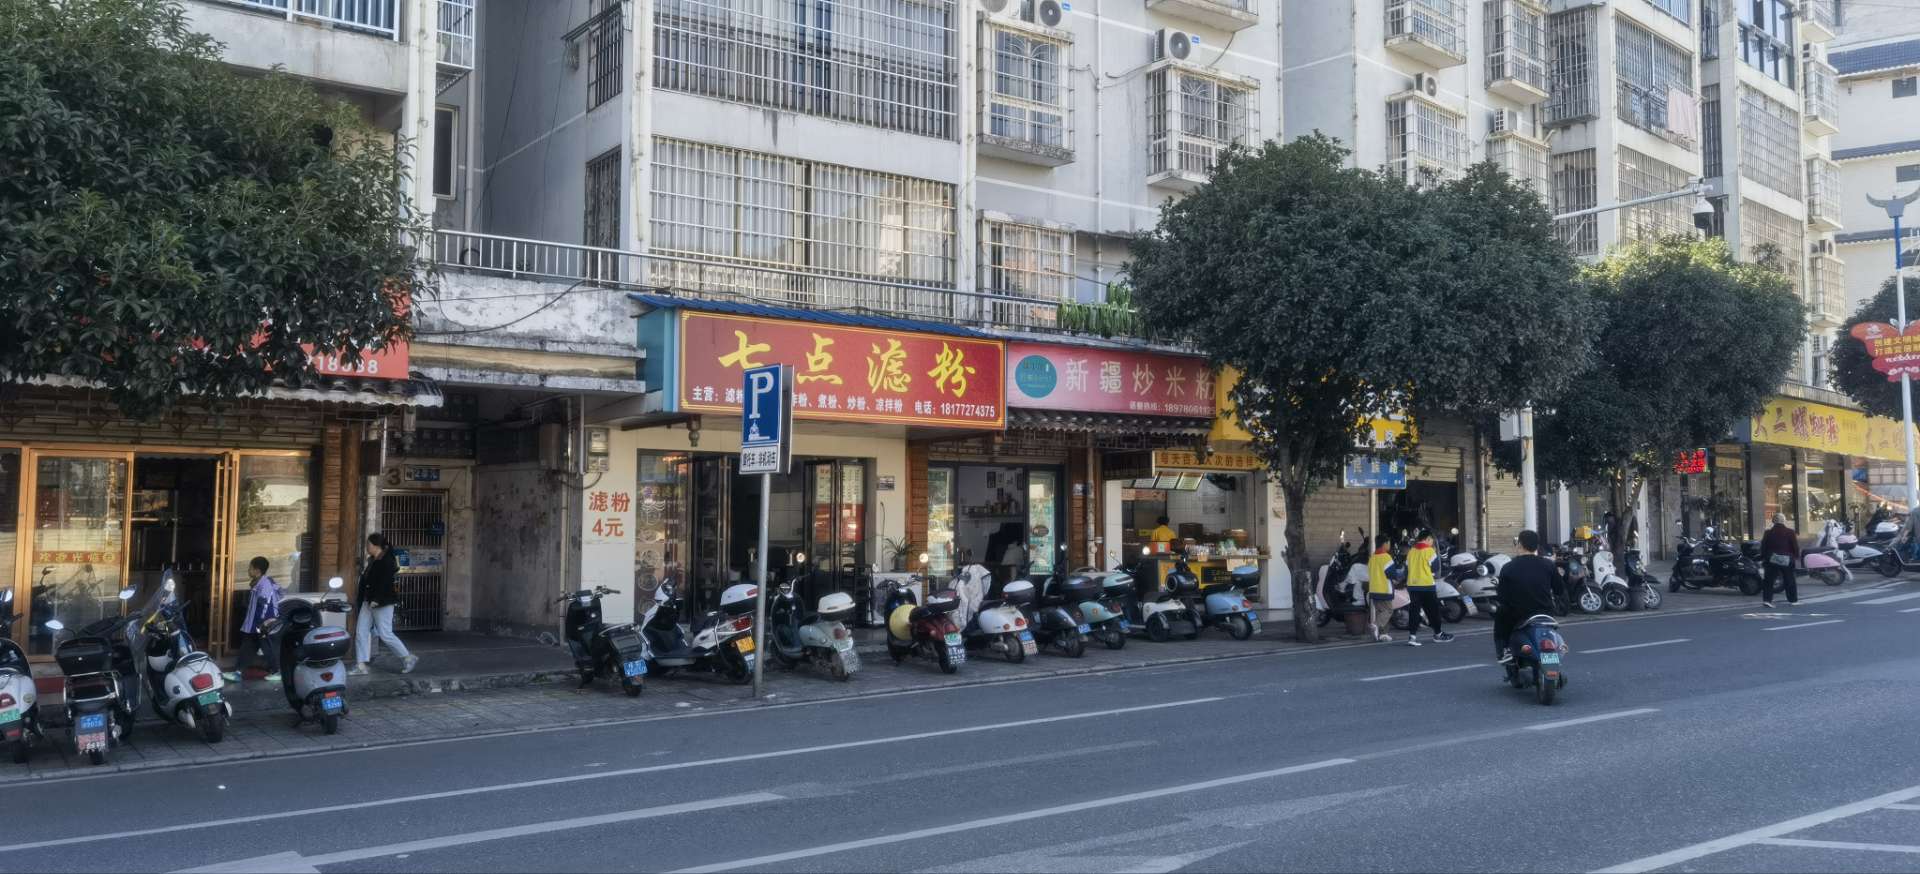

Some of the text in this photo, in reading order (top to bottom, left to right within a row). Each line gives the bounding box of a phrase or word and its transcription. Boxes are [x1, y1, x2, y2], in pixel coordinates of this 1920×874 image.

[718, 331, 976, 398] 七点滤粉
[1065, 358, 1216, 401] 新疆炒米粉
[749, 371, 774, 419] P
[589, 490, 630, 512] 滤粉
[592, 518, 624, 537] 4元
